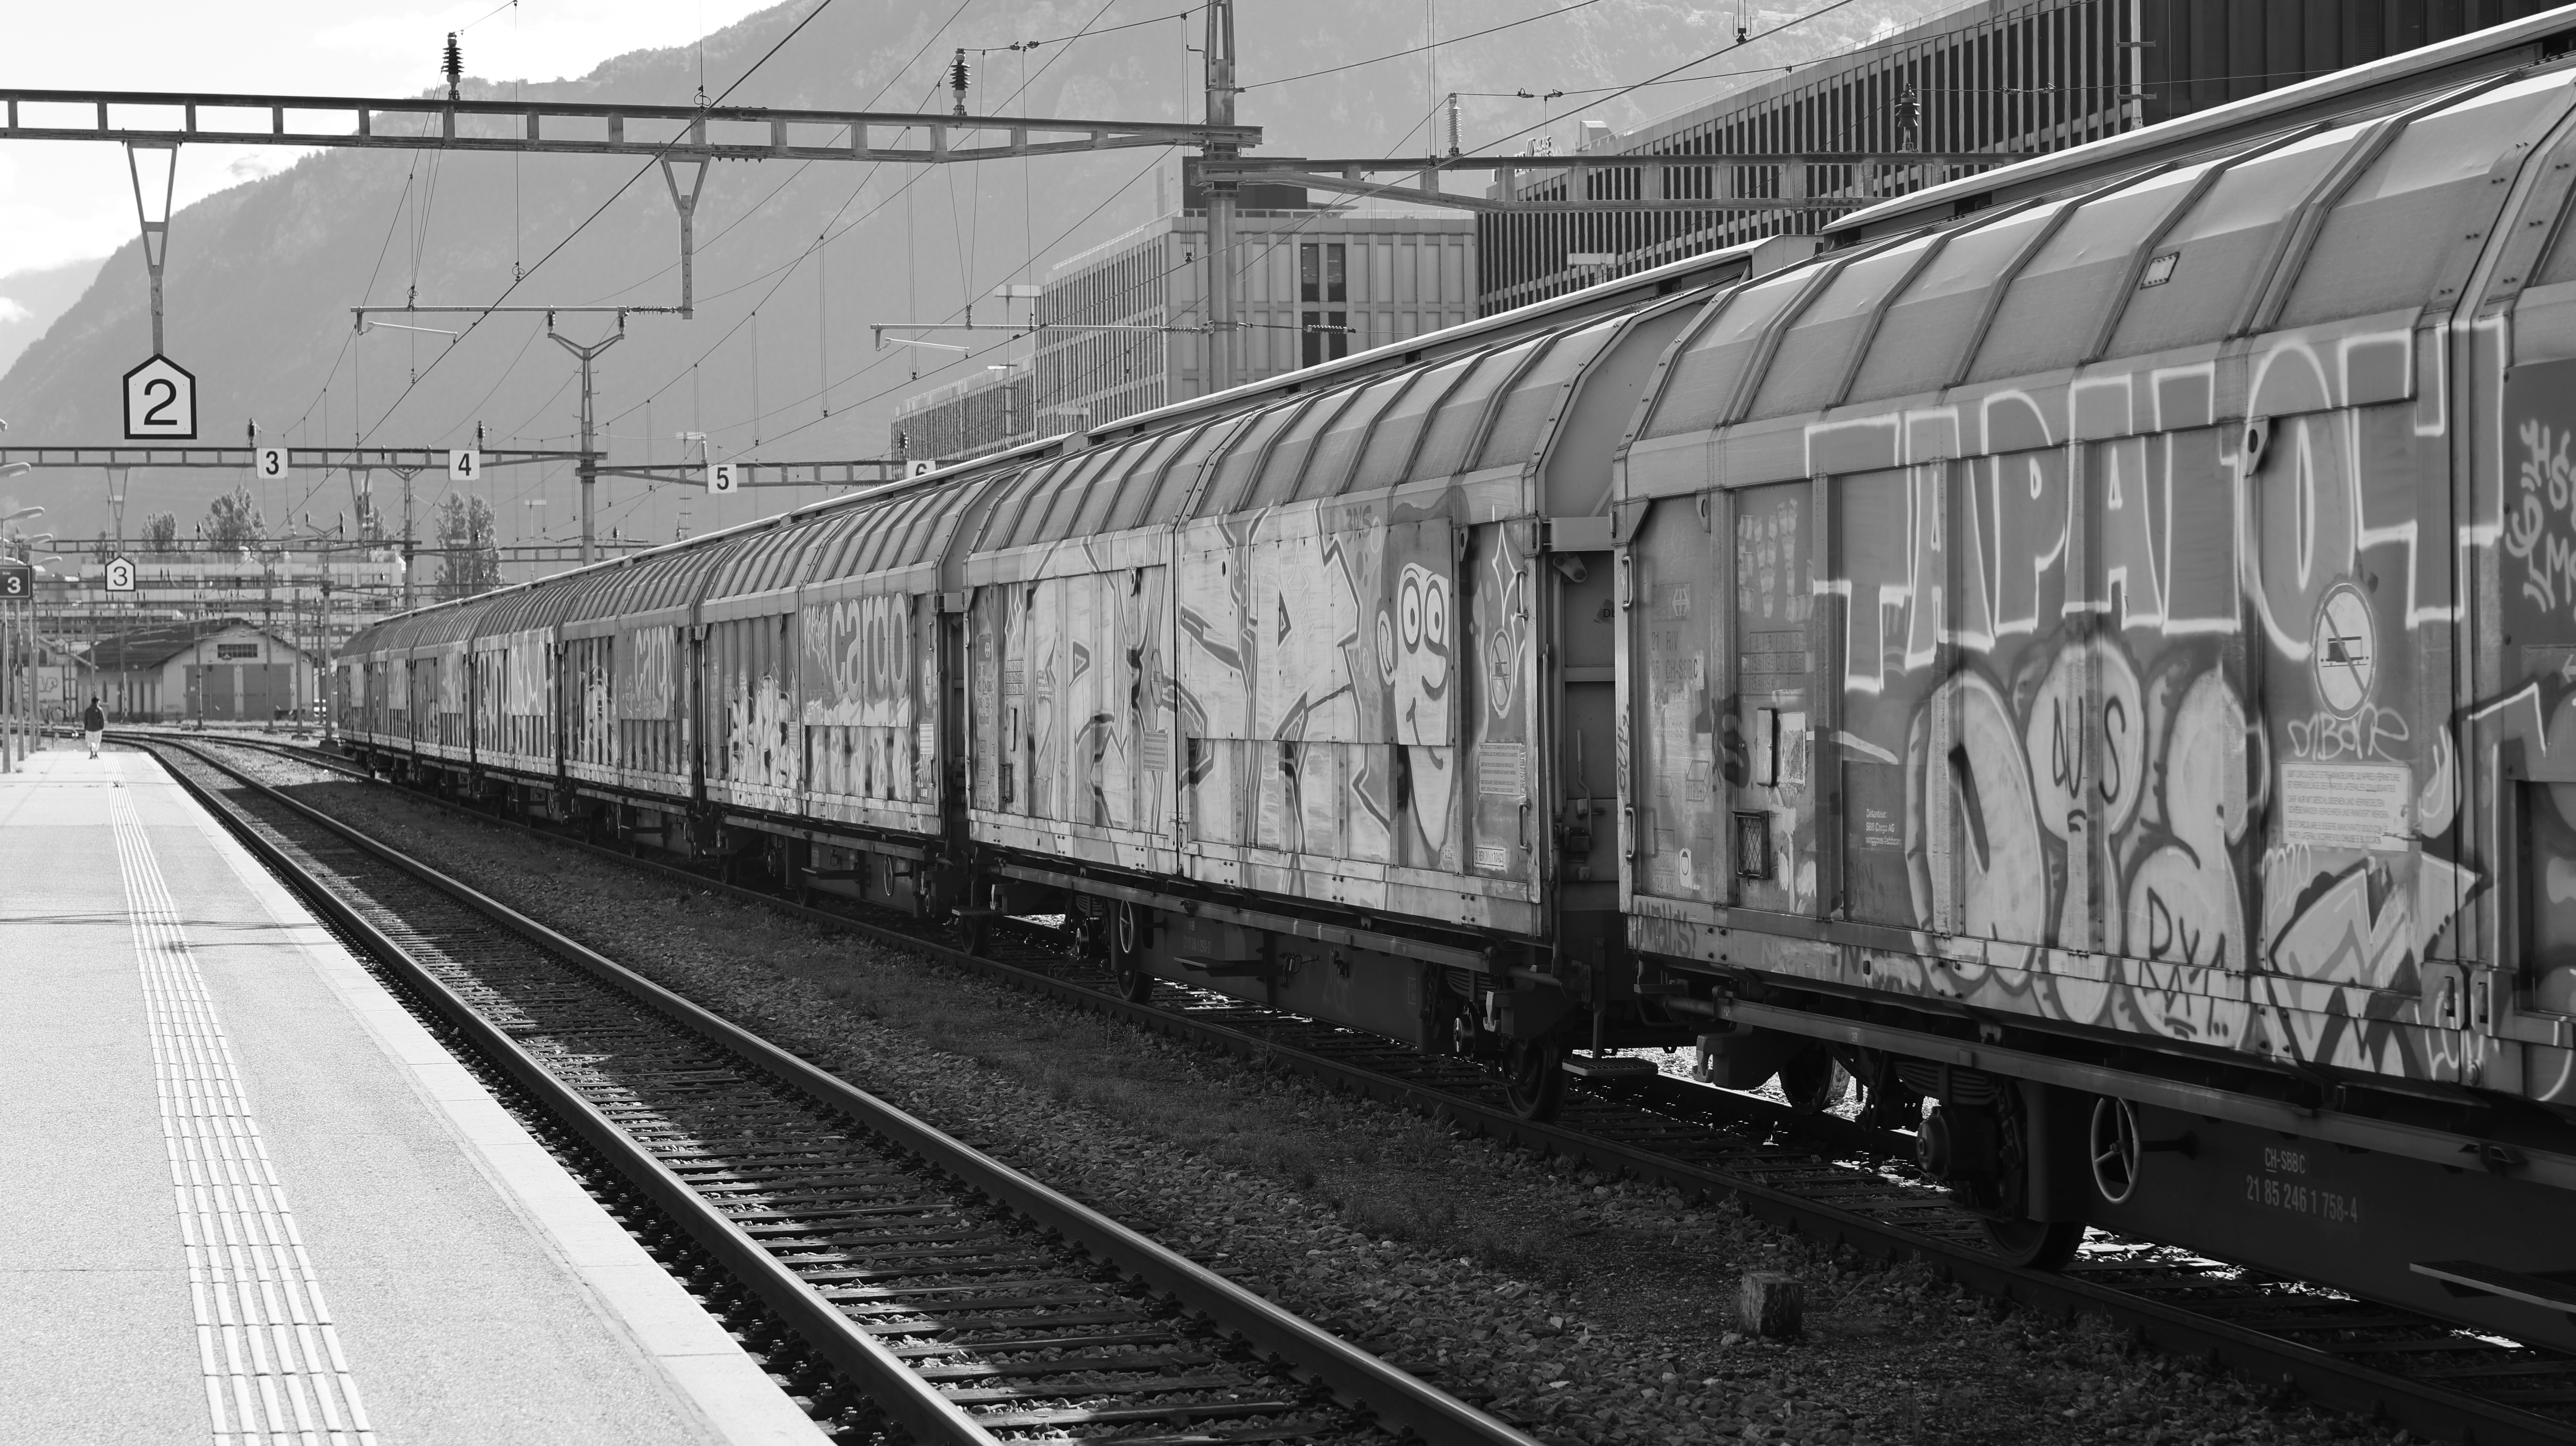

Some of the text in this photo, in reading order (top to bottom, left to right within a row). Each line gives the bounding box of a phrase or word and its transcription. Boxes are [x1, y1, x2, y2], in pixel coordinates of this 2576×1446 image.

[144, 379, 177, 425] 2
[266, 451, 279, 475] 3
[458, 453, 471, 476] 4
[915, 463, 927, 476] 6
[717, 467, 729, 490] 5
[7, 576, 21, 594] 3
[113, 566, 128, 586] 3
[1652, 630, 1678, 652] 21 RIV
[1851, 1032, 1858, 1042] 2R
[2265, 1147, 2306, 1174] CH-SBBC
[2246, 1174, 2358, 1224] 21 85 246 1 758-4
